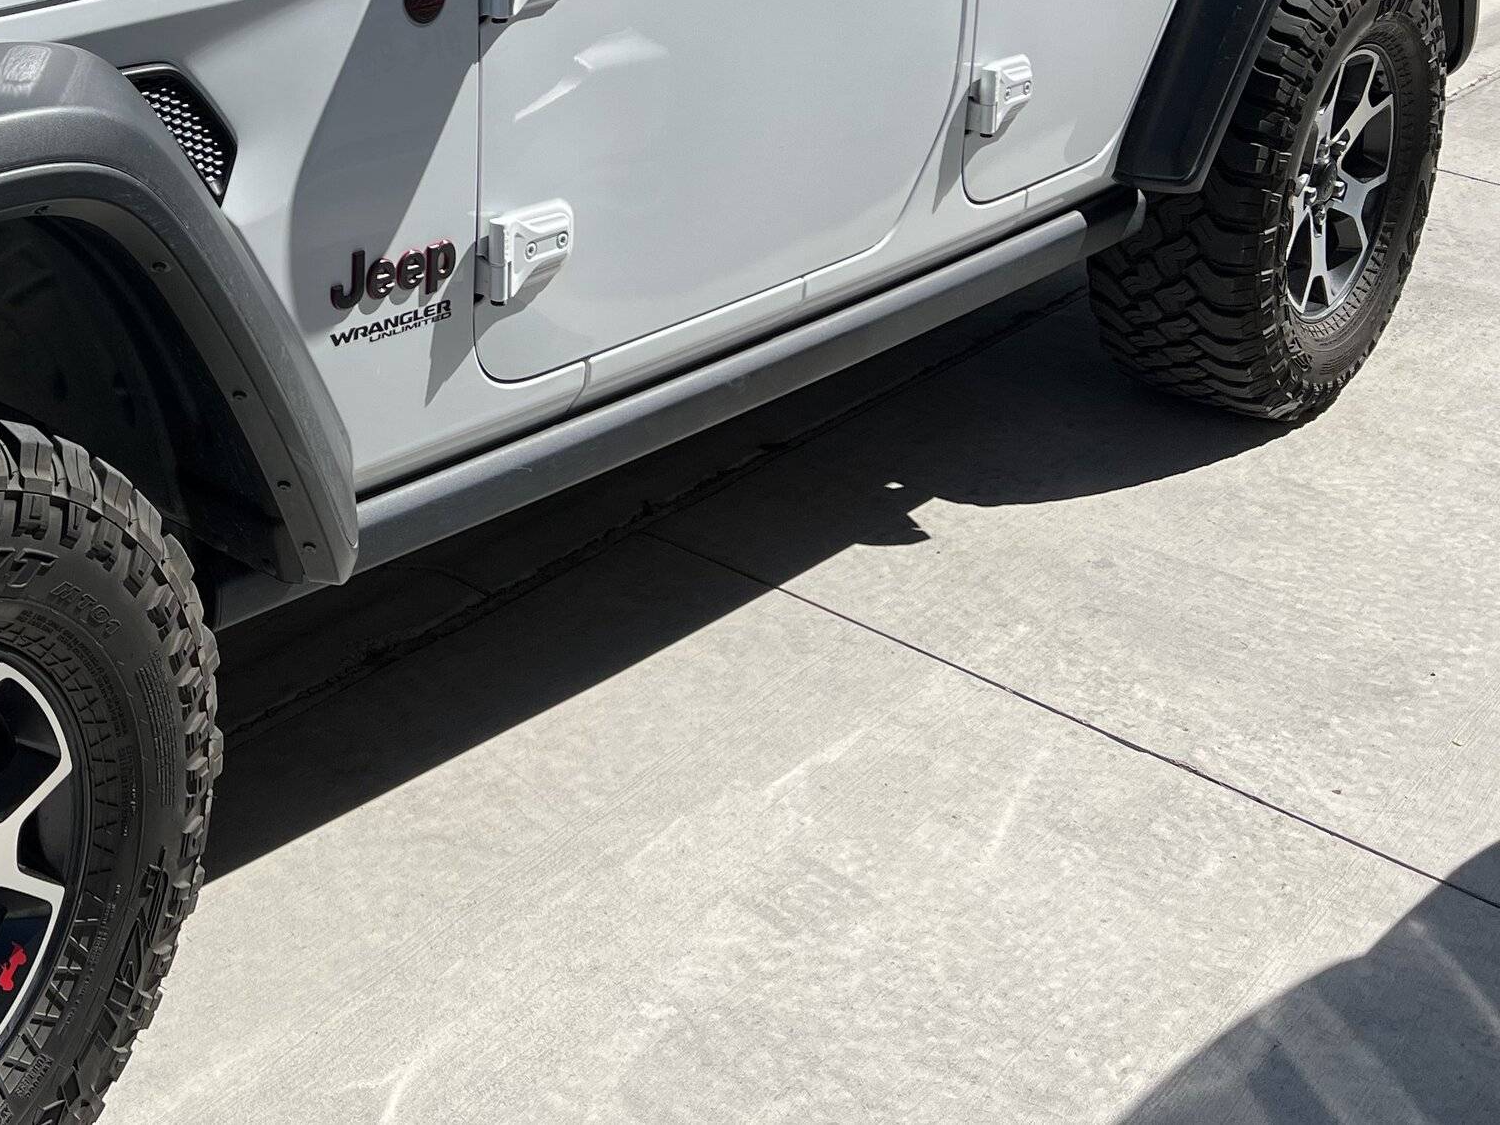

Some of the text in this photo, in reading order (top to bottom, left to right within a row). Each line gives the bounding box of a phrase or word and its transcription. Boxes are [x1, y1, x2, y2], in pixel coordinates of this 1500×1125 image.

[329, 239, 457, 311] Jeep
[329, 299, 452, 347] WRANGLER
[368, 311, 453, 343] UNLIMITED
